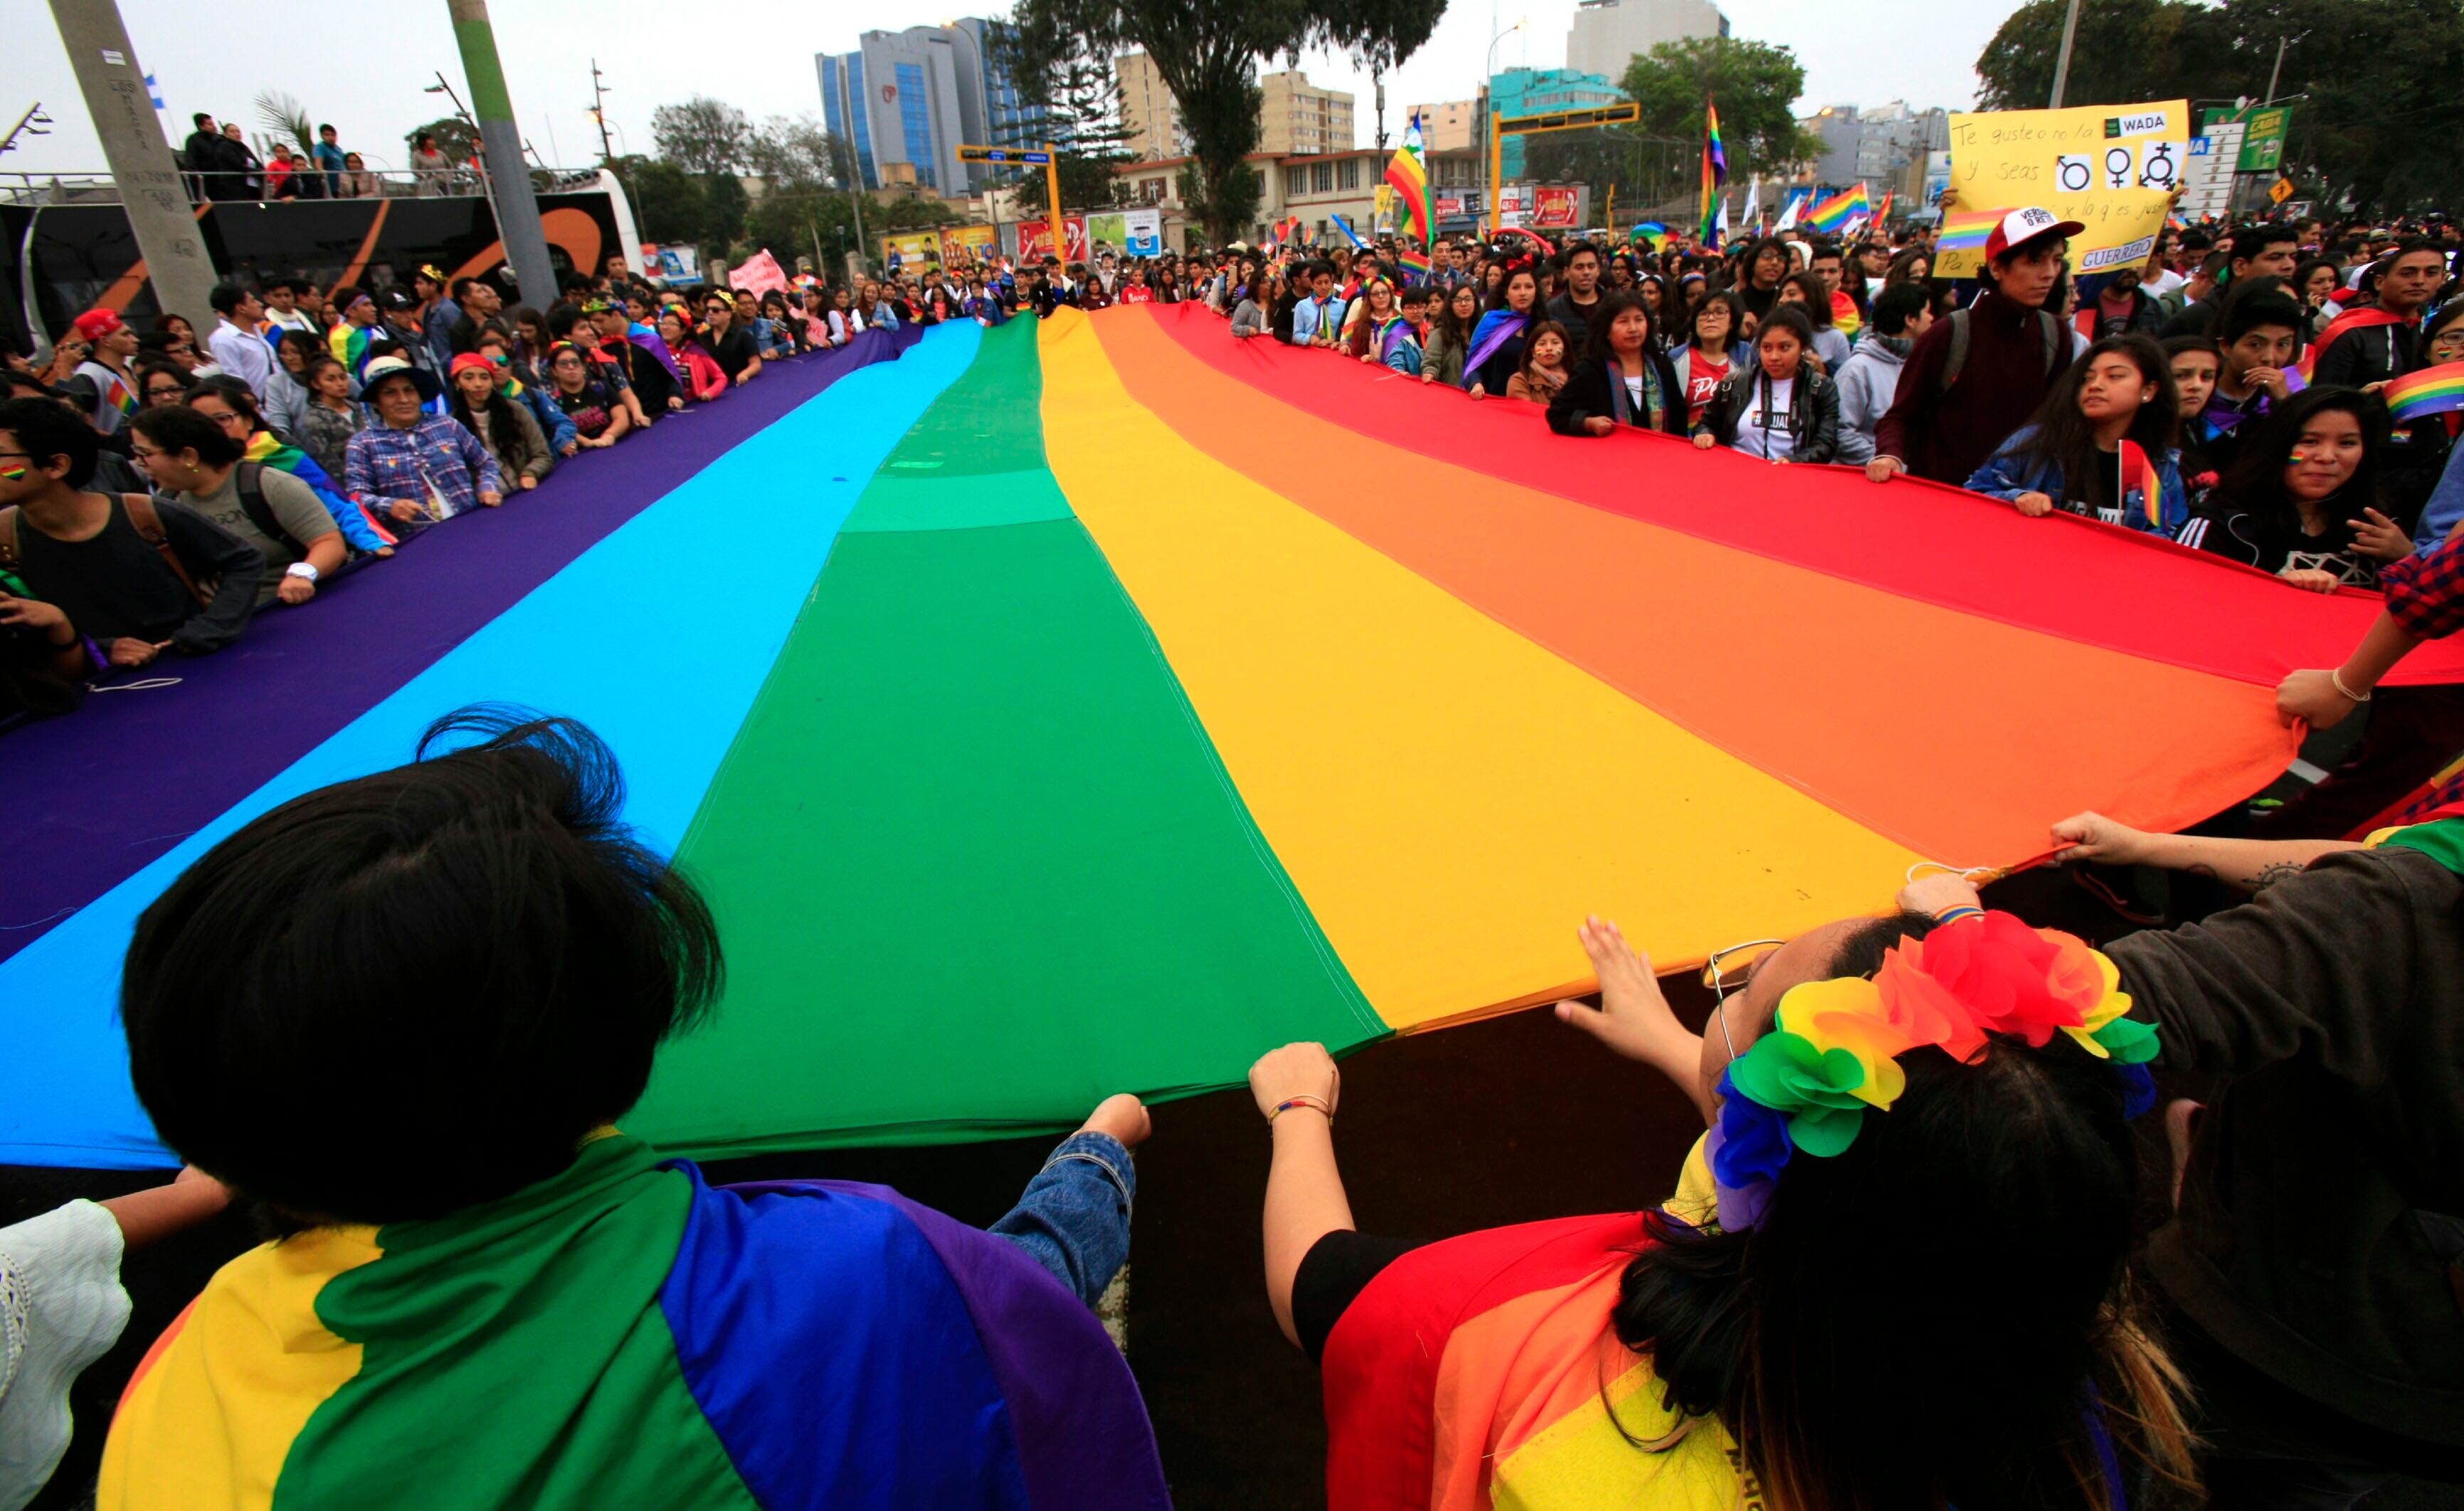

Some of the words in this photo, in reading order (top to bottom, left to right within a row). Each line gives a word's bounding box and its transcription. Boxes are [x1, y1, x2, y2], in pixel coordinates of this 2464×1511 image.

[1952, 122, 1977, 147] Te
[1992, 123, 2033, 146] guste
[2037, 128, 2046, 139] o
[2052, 130, 2068, 139] no
[2073, 122, 2093, 139] la
[2123, 115, 2165, 132] WADA
[1964, 160, 1979, 181] y
[1997, 162, 2041, 181] seas
[2063, 206, 2074, 219] x
[2083, 239, 2152, 268] GUERRERO
